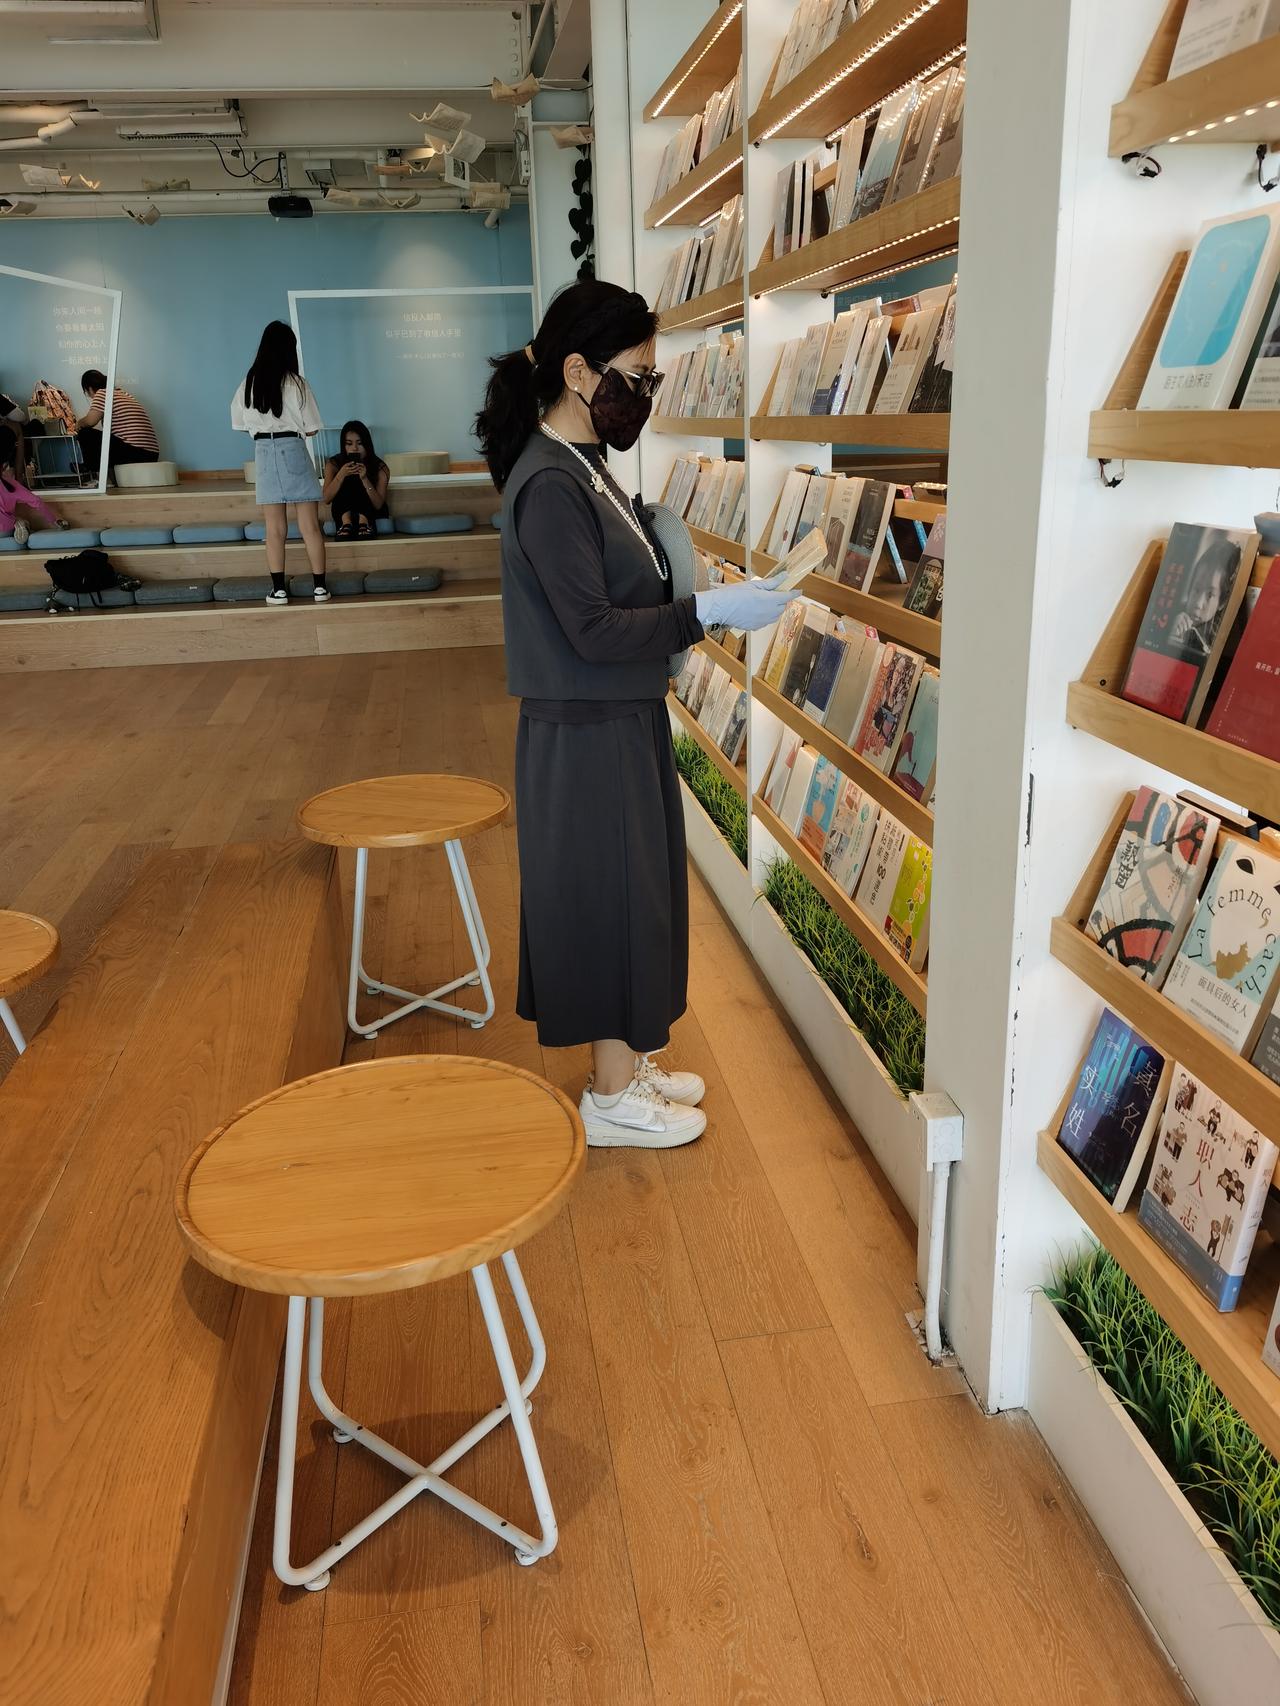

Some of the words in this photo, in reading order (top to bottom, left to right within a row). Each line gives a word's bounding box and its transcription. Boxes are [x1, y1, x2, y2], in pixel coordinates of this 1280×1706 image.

[1187, 928, 1206, 959] La
[1206, 888, 1272, 920] femme
[1198, 975, 1247, 1018] 面具后的女人
[1180, 1139, 1215, 1233] 职人志
